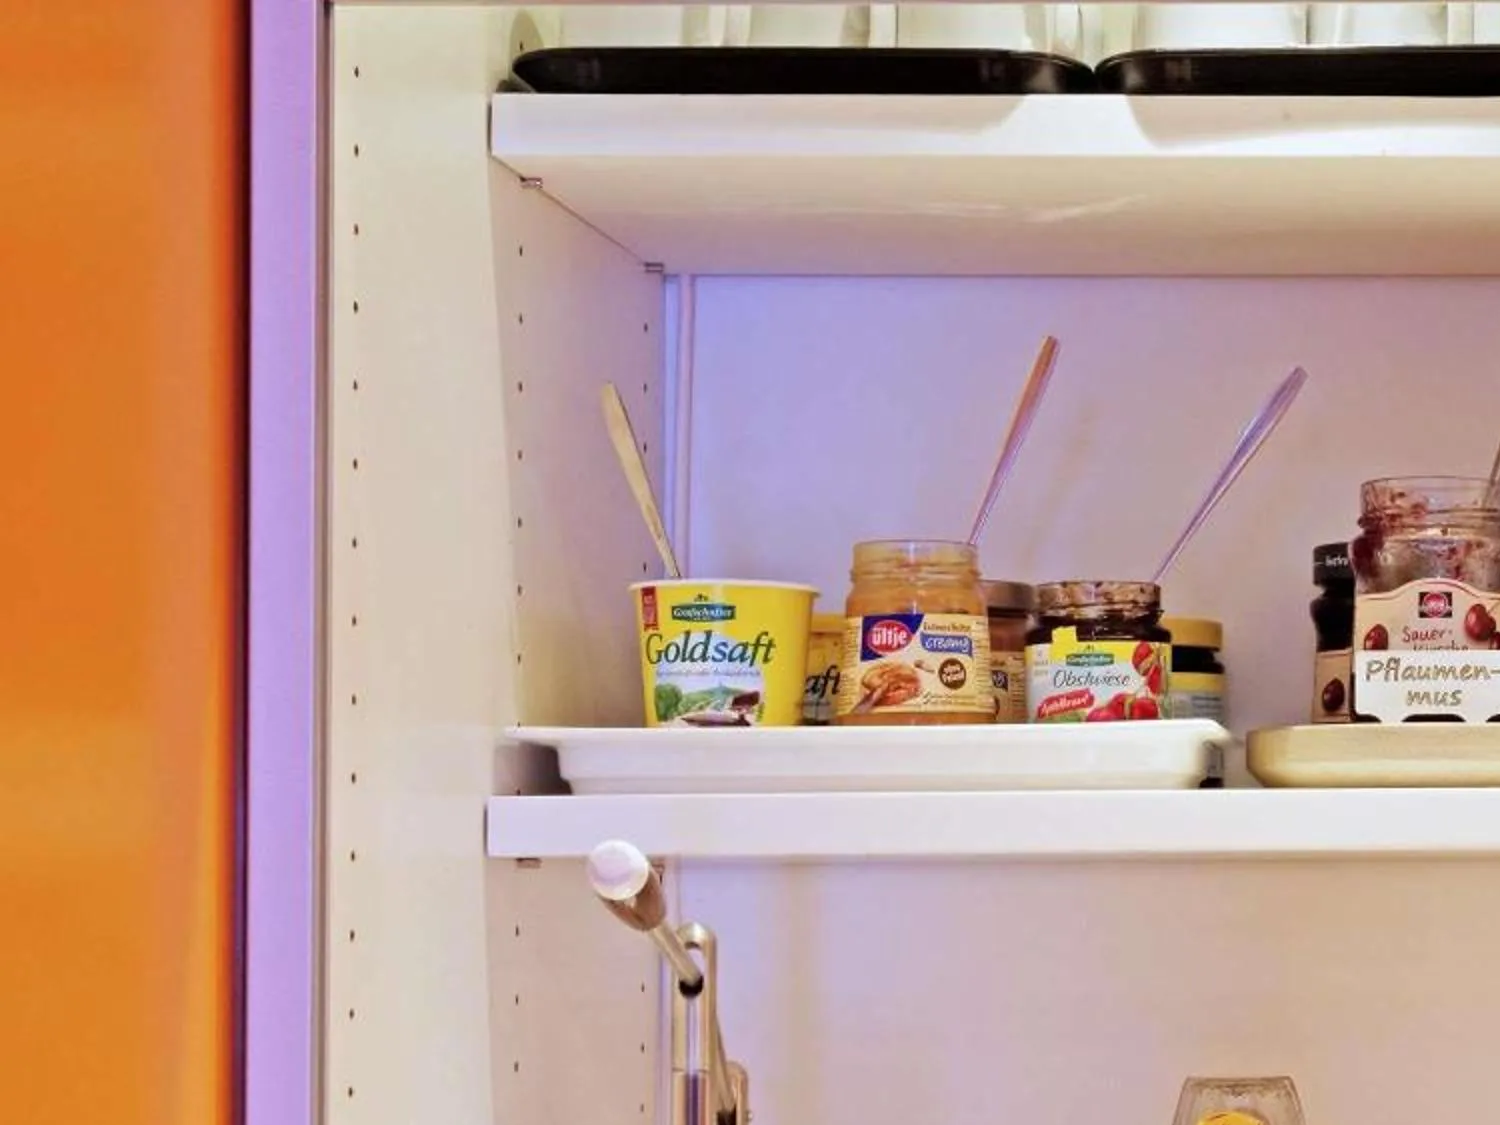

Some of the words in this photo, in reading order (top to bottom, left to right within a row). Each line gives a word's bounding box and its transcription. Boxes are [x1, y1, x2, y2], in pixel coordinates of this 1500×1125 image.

[645, 629, 776, 667] Goldsaft
[871, 630, 908, 653] ültje
[1053, 669, 1132, 688] Obstwiese
[1405, 690, 1463, 707] mus
